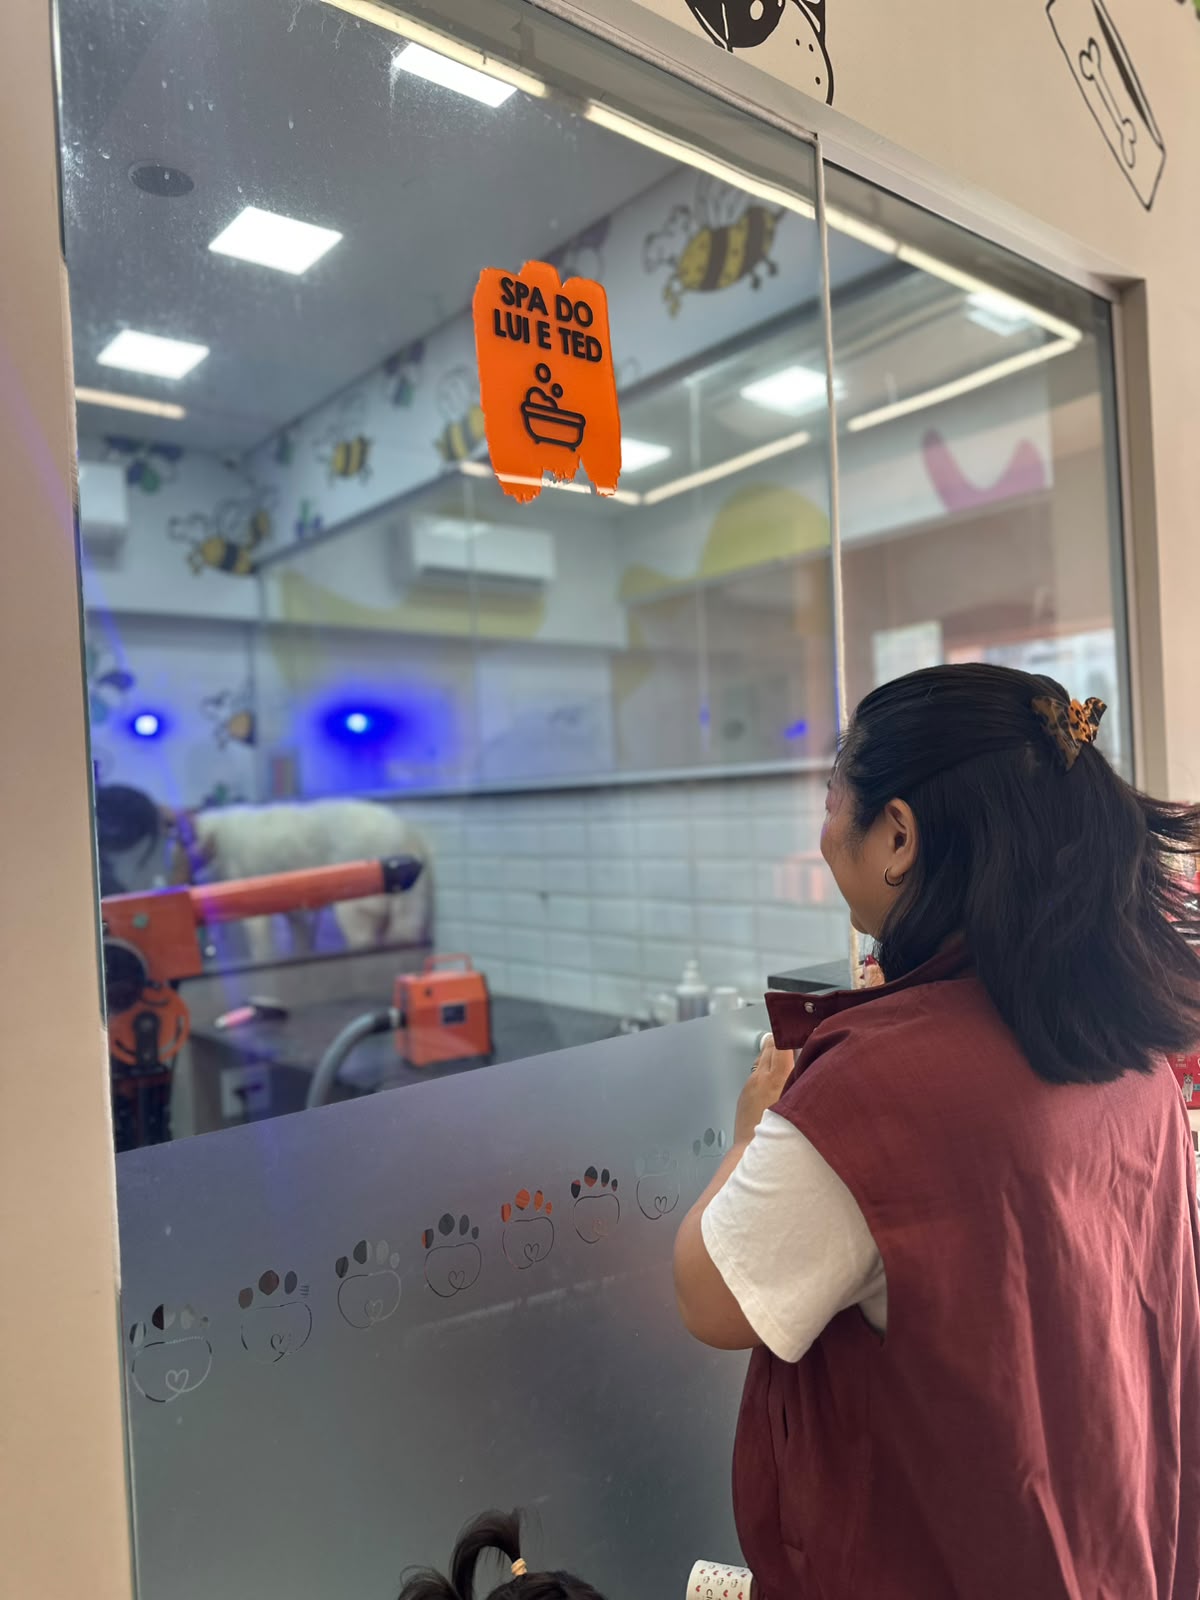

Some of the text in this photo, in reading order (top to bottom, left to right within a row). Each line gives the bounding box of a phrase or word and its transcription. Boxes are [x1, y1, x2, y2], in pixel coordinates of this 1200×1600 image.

[501, 277, 593, 327] SPA DO
[494, 308, 603, 363] LUI E TED
